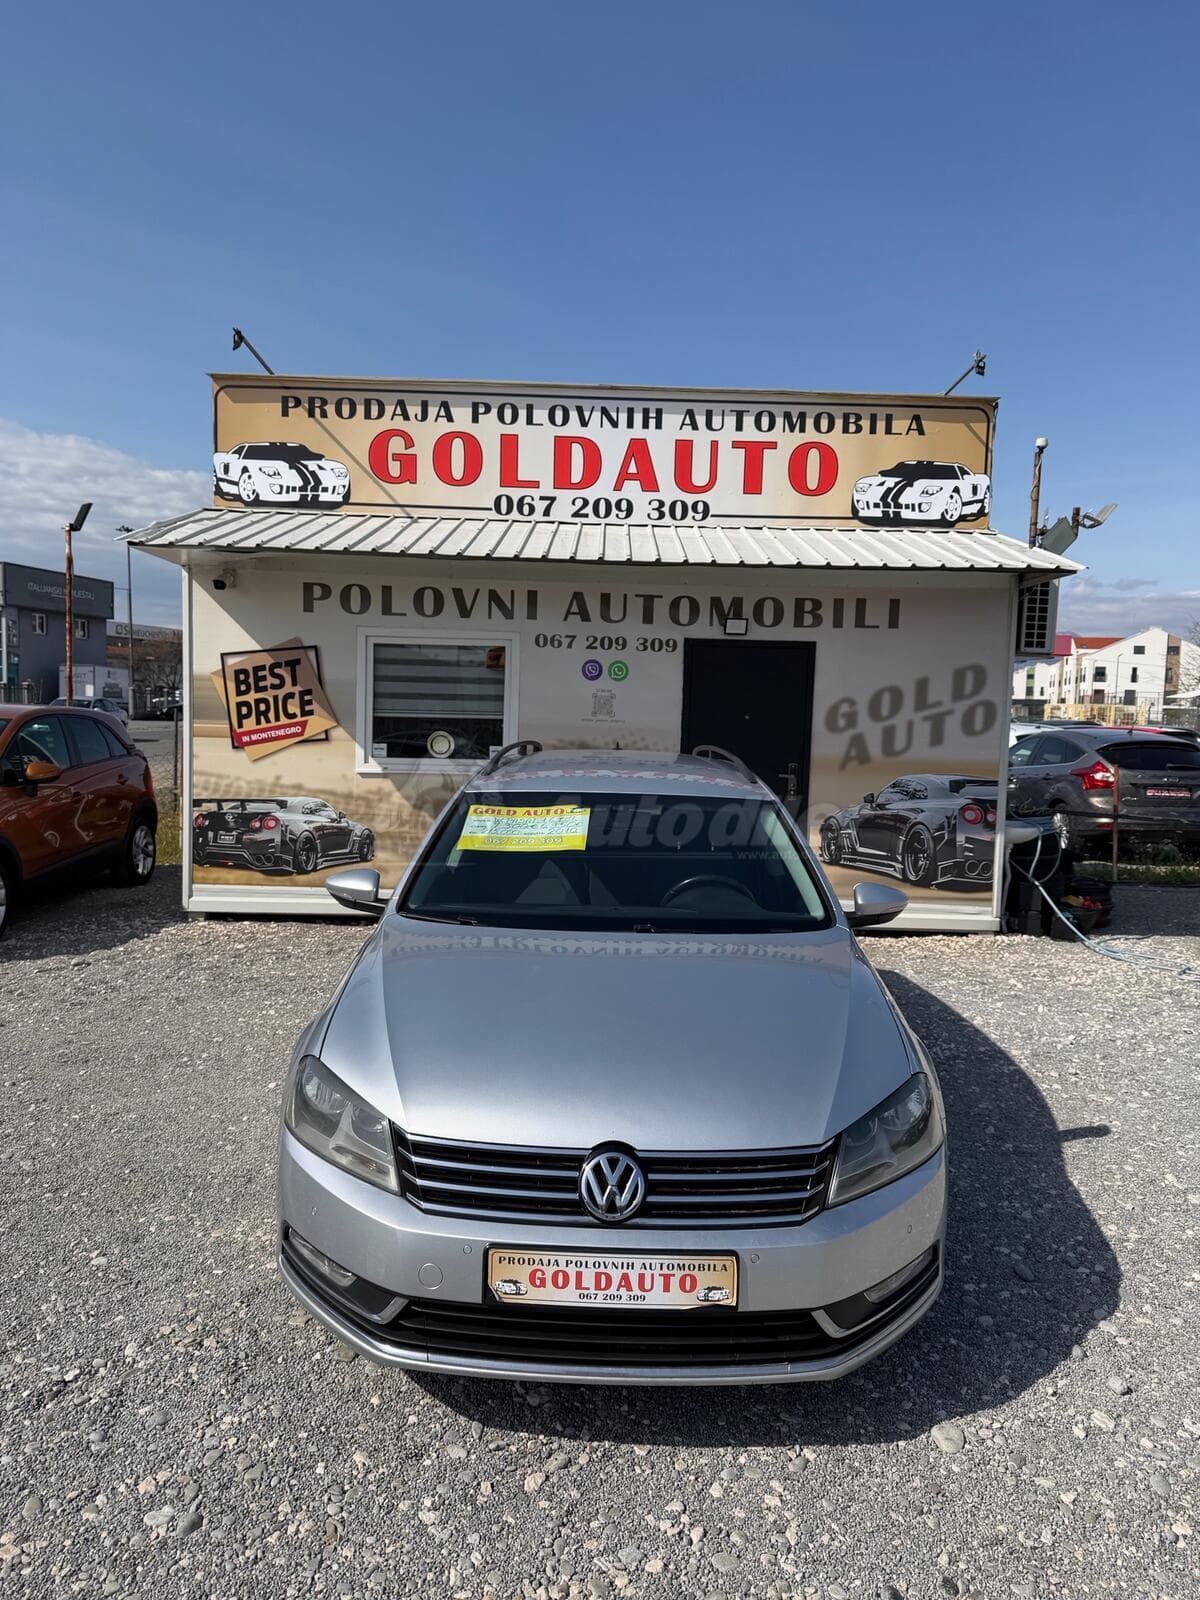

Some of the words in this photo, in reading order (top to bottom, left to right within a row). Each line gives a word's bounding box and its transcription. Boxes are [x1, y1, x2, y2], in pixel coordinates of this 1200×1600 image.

[280, 394, 456, 423] PRODAJA
[471, 402, 664, 430] POLOVNIH
[679, 408, 926, 436] AUTOMOBILA
[368, 428, 839, 497] GOLDAUTO
[493, 493, 557, 518] 067
[571, 494, 635, 520] 209
[647, 498, 712, 522] 309
[302, 581, 539, 621] POLOVNI
[562, 590, 901, 630] AUTOMOBILI
[534, 633, 577, 649] 067
[585, 635, 628, 651] 209
[635, 637, 678, 653] 309
[234, 658, 302, 697] BEST
[235, 688, 315, 730] PRICE
[824, 664, 988, 734] GOLD
[241, 733, 251, 744] IN
[251, 726, 302, 742] MONTENEGRO
[838, 700, 998, 772] AUTO
[472, 806, 518, 817] GOLD
[521, 806, 566, 817] AUTO
[498, 1256, 560, 1268] PRODAJA
[565, 1258, 635, 1271] POLOVNIH
[639, 1261, 729, 1273] AUTOMOBILA
[528, 1268, 698, 1294] GOLDAUTO
[579, 1291, 597, 1301] 067
[602, 1293, 622, 1302] 209
[626, 1293, 647, 1303] 309
